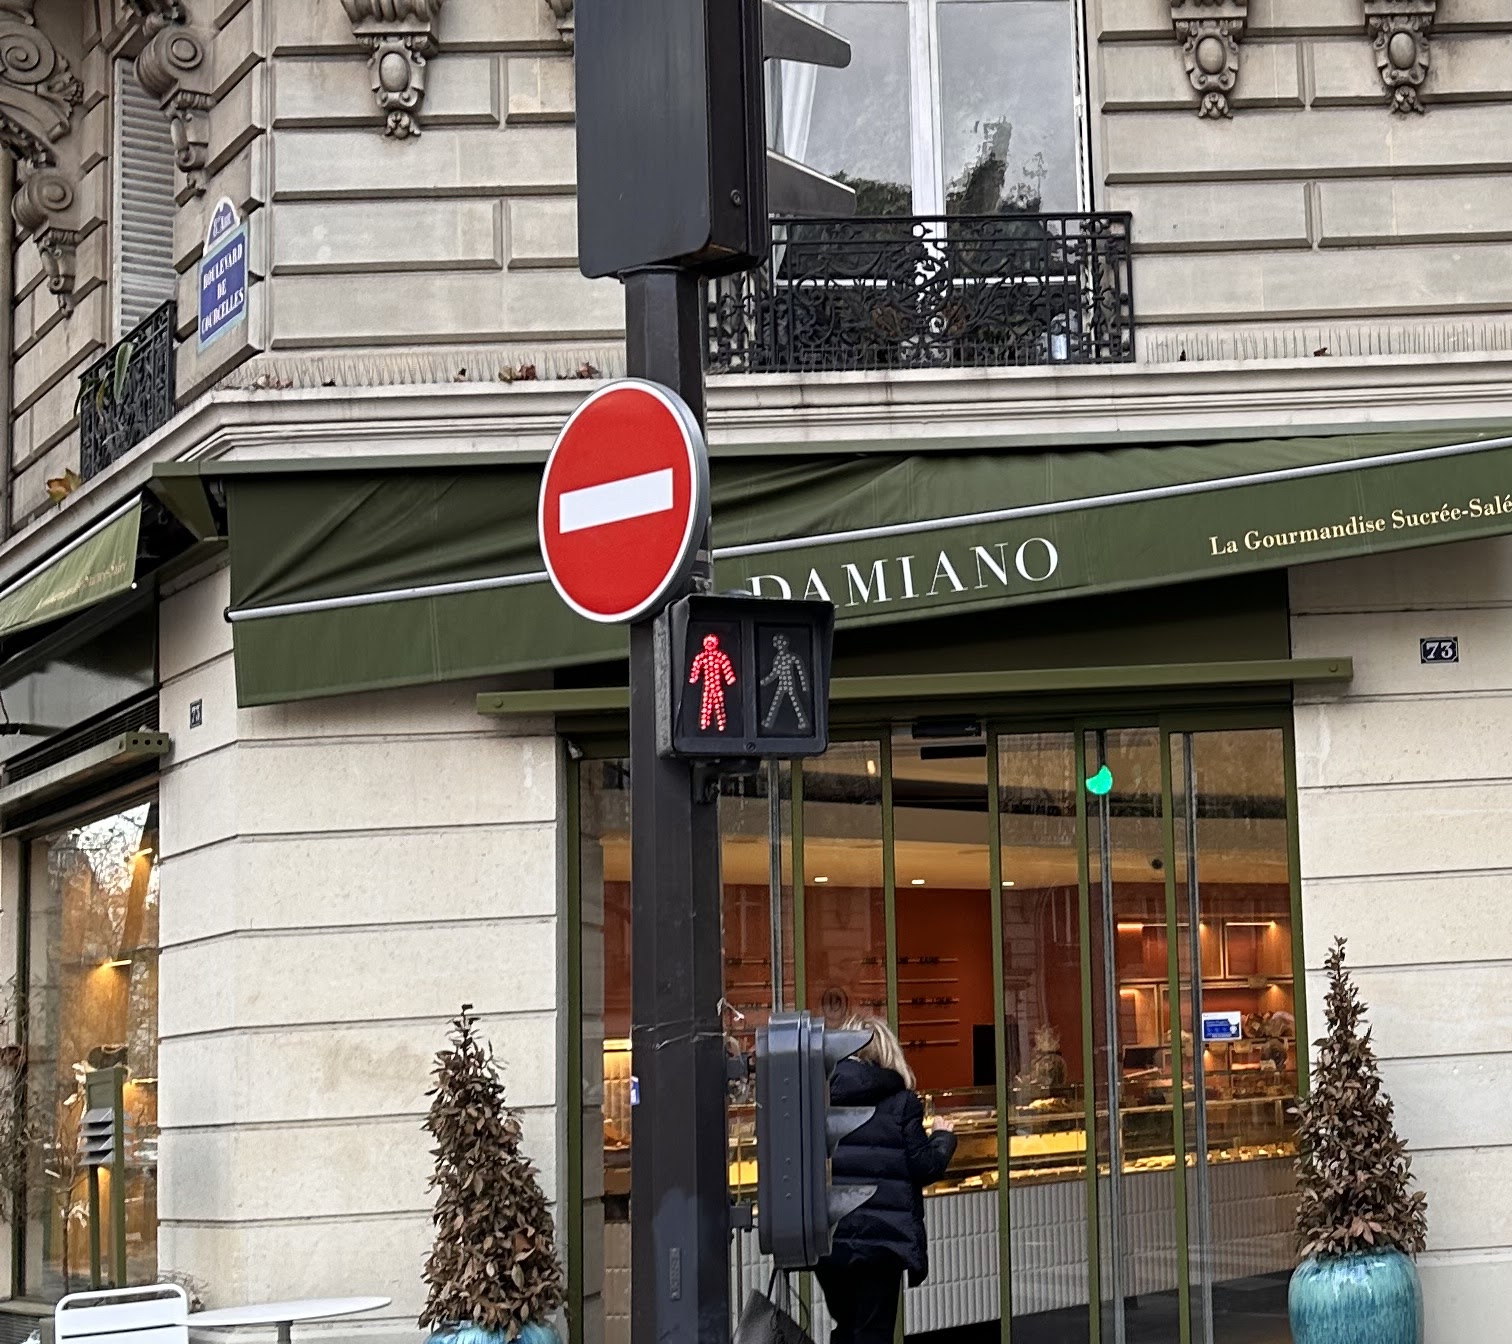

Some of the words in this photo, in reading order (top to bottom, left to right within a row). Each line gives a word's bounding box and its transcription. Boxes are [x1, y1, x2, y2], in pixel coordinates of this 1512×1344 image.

[203, 243, 243, 291] BOULEVARD
[201, 287, 245, 335] COURCELLES
[216, 278, 227, 301] DE
[1209, 535, 1238, 556] La
[1244, 515, 1386, 551] Gourmandise
[745, 537, 1059, 609] DAMIANO
[1426, 641, 1453, 659] 73
